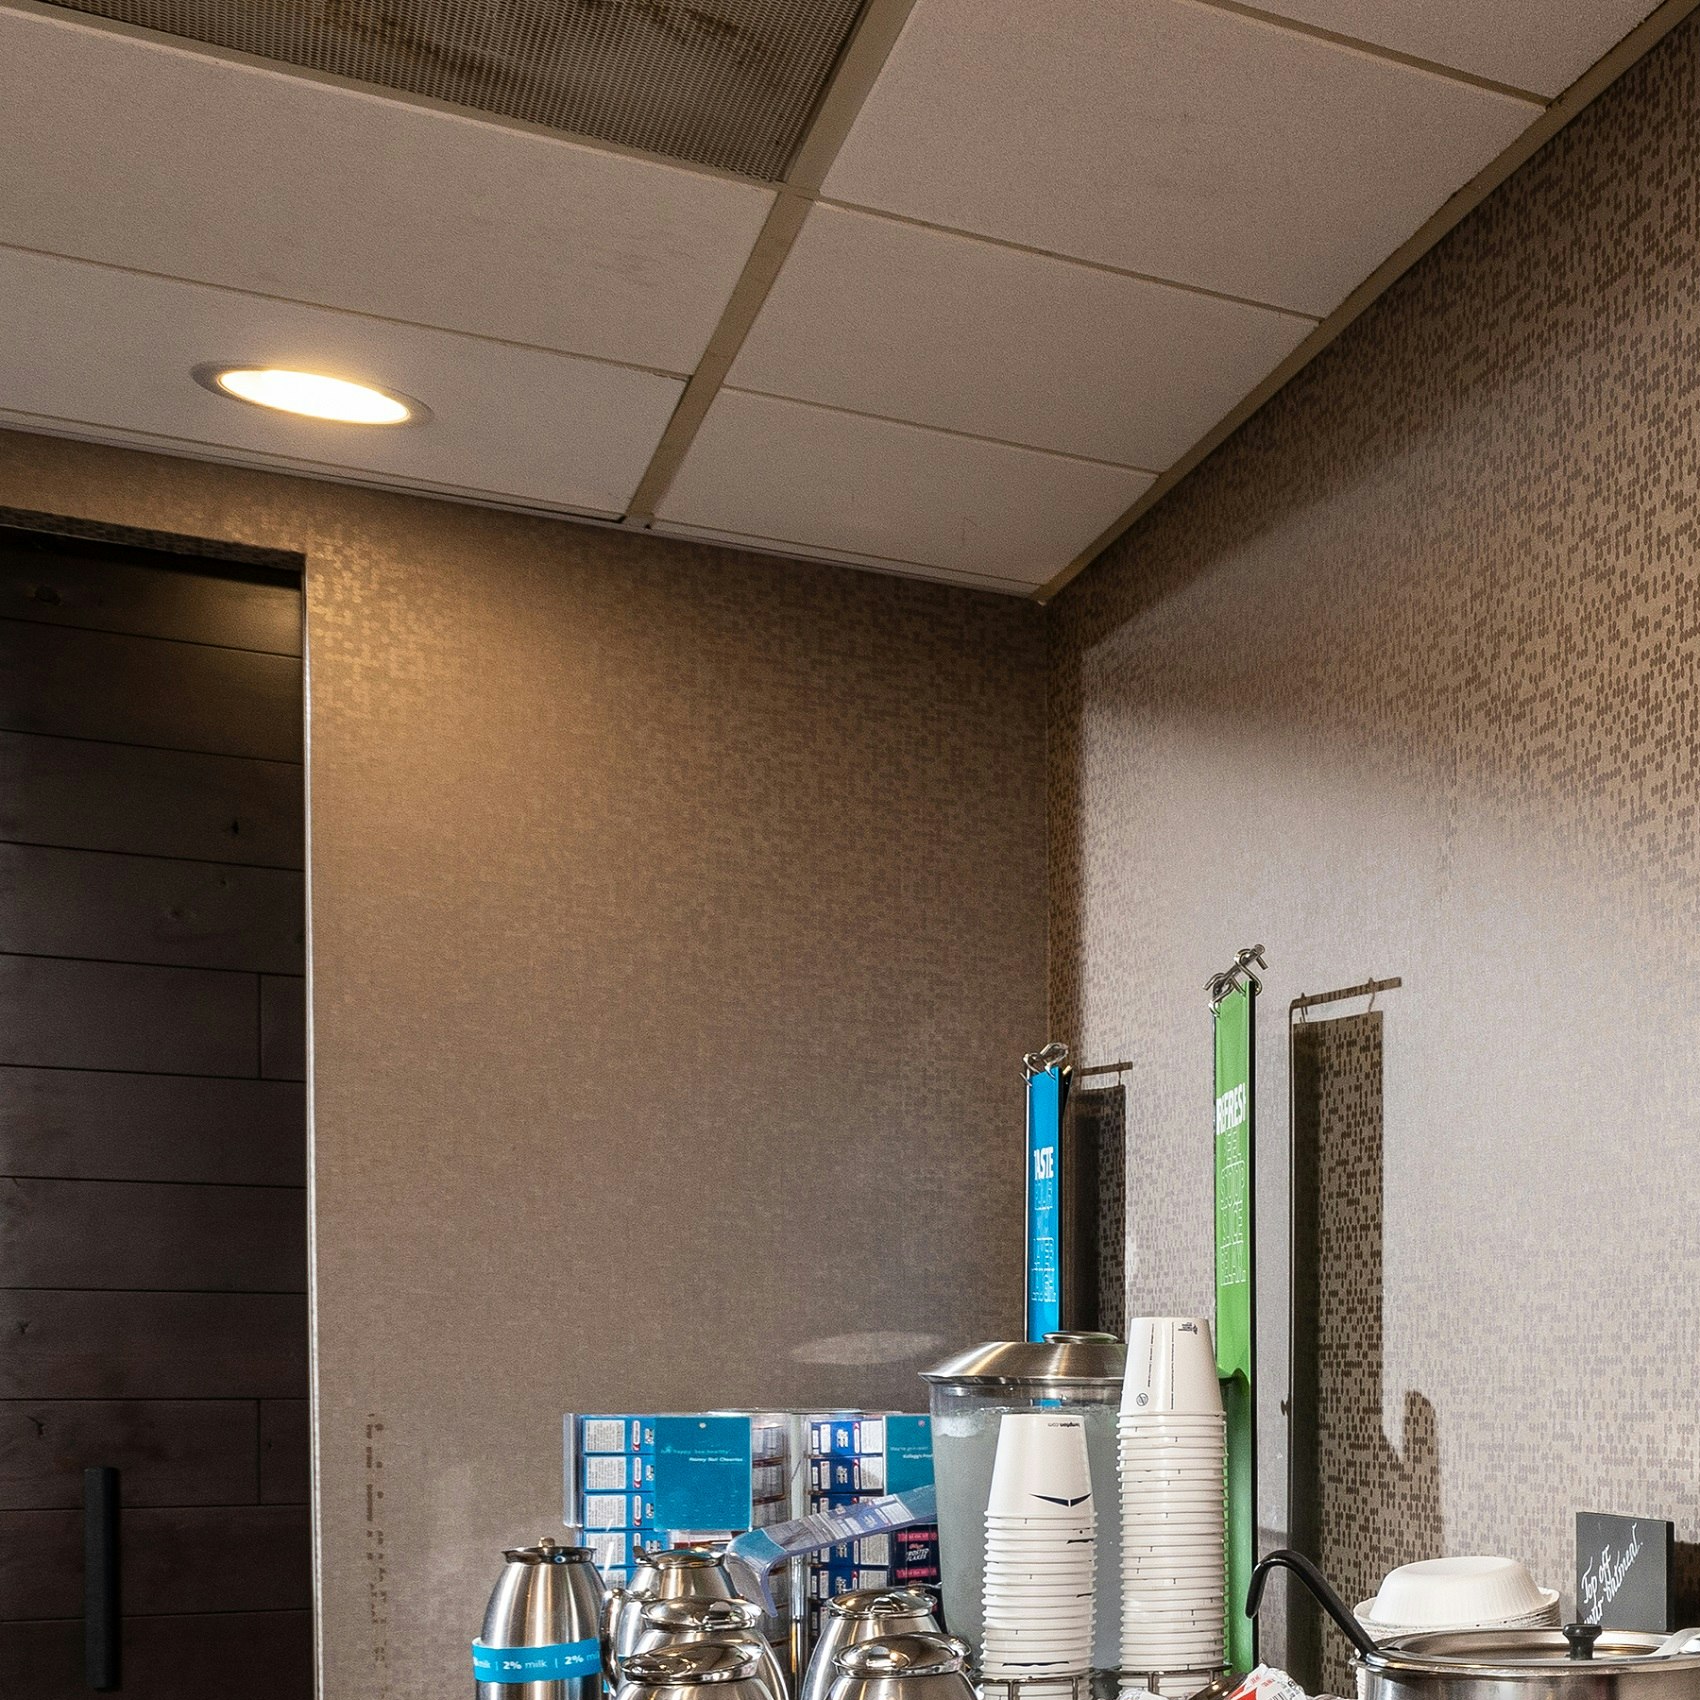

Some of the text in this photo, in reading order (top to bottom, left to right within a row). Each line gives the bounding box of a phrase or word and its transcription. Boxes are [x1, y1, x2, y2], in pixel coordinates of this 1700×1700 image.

[502, 1660, 522, 1670] 2%
[525, 1659, 547, 1669] milk
[564, 1655, 585, 1665] 2%
